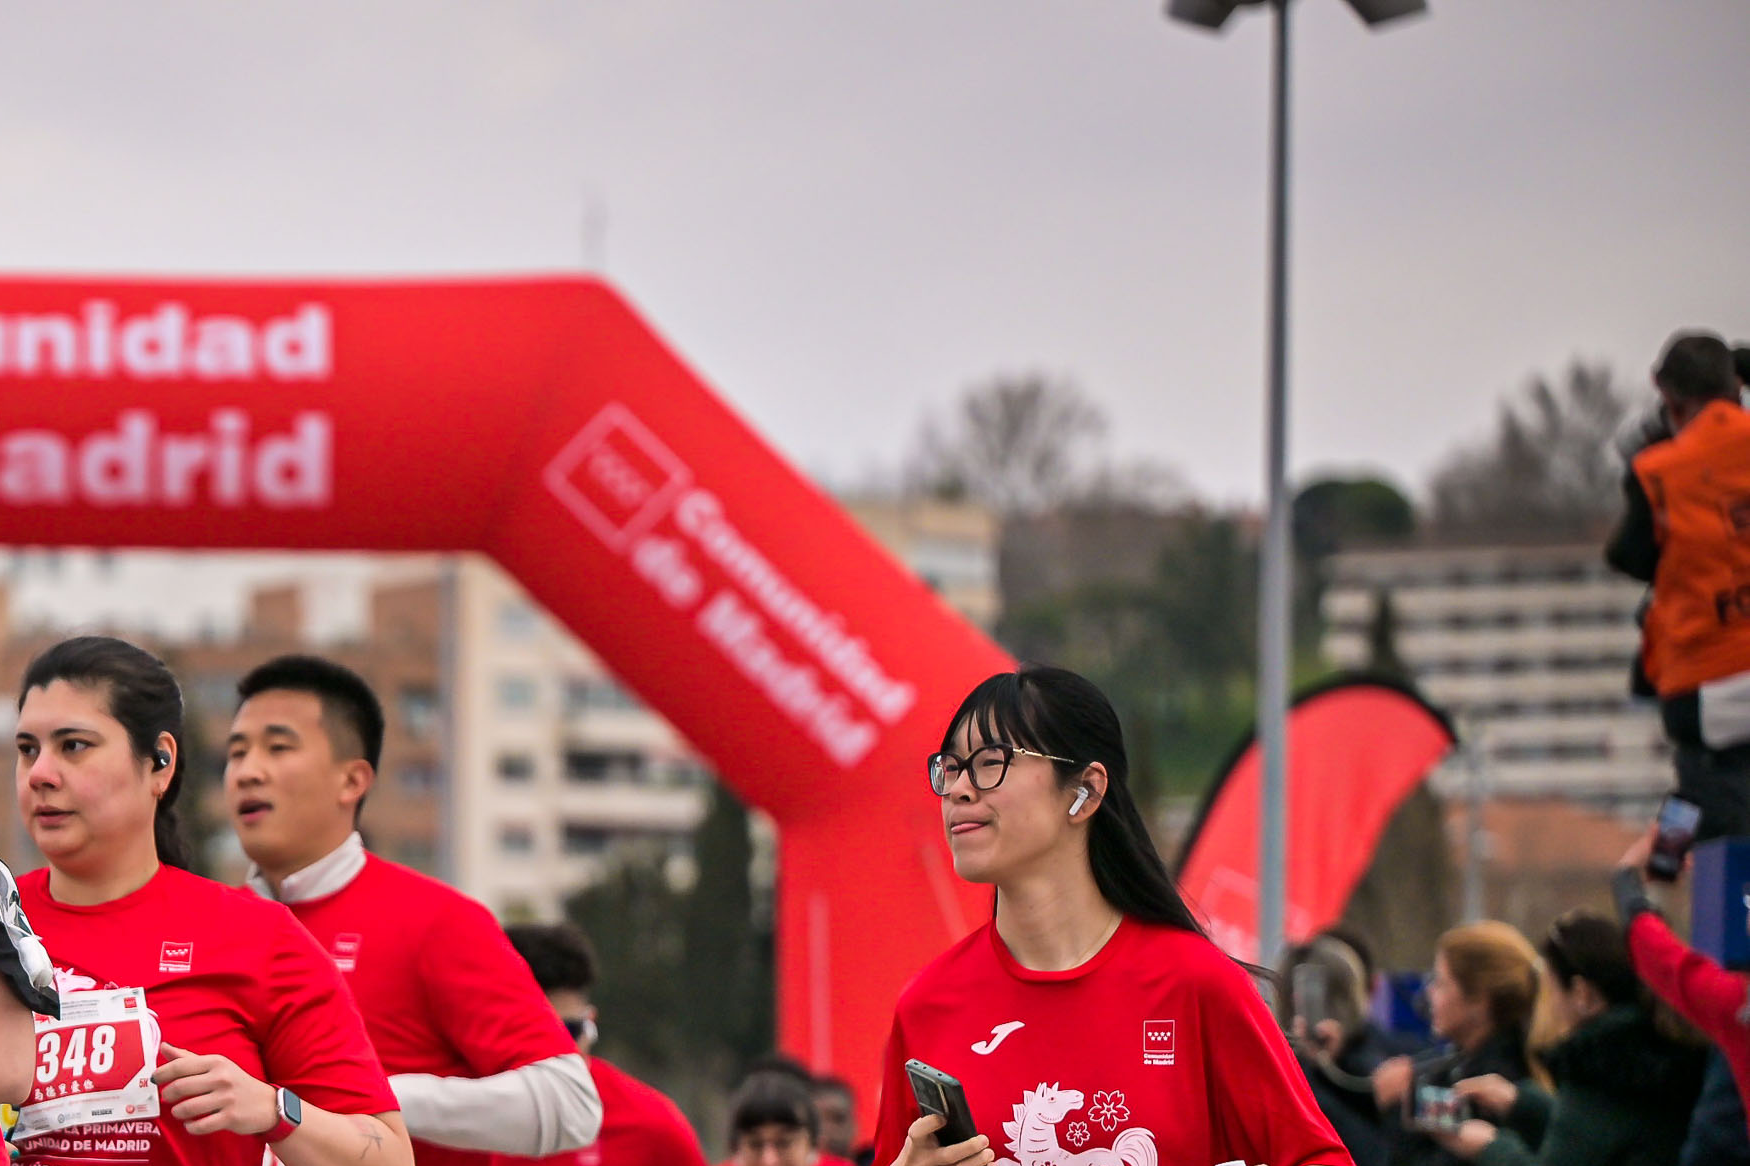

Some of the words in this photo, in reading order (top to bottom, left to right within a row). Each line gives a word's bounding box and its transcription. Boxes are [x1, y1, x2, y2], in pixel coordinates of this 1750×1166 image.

[675, 489, 917, 725] Comunidad
[633, 533, 702, 607] de
[698, 592, 880, 767] Madrid
[36, 1025, 116, 1083] 348
[73, 1140, 92, 1151] DE
[95, 1139, 151, 1152] MADRID
[83, 1121, 161, 1136] PRIMAVERA
